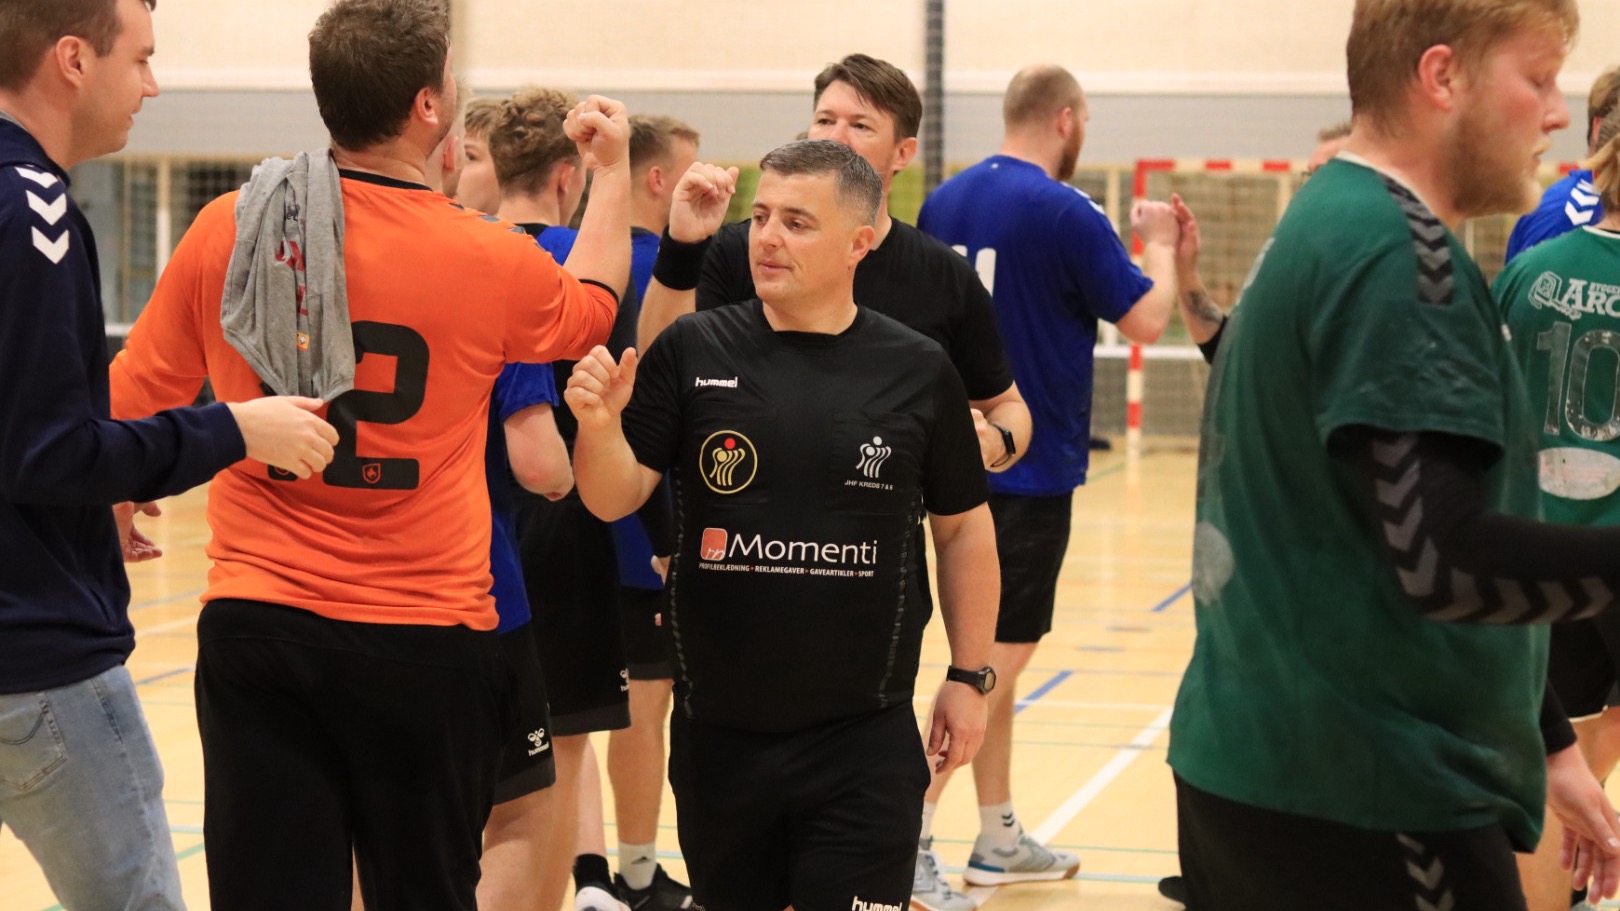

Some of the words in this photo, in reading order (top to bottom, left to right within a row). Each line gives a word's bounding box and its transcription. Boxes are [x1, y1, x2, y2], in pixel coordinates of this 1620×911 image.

[695, 376, 738, 388] hummel
[1537, 321, 1620, 441] 10
[859, 481, 880, 489] KREDS
[728, 533, 877, 564] Momenti
[699, 563, 750, 572] PROFILBEKLÆDNING
[755, 565, 804, 575] REKLAMEGAVER
[809, 568, 854, 577] GAVEARTIKLER
